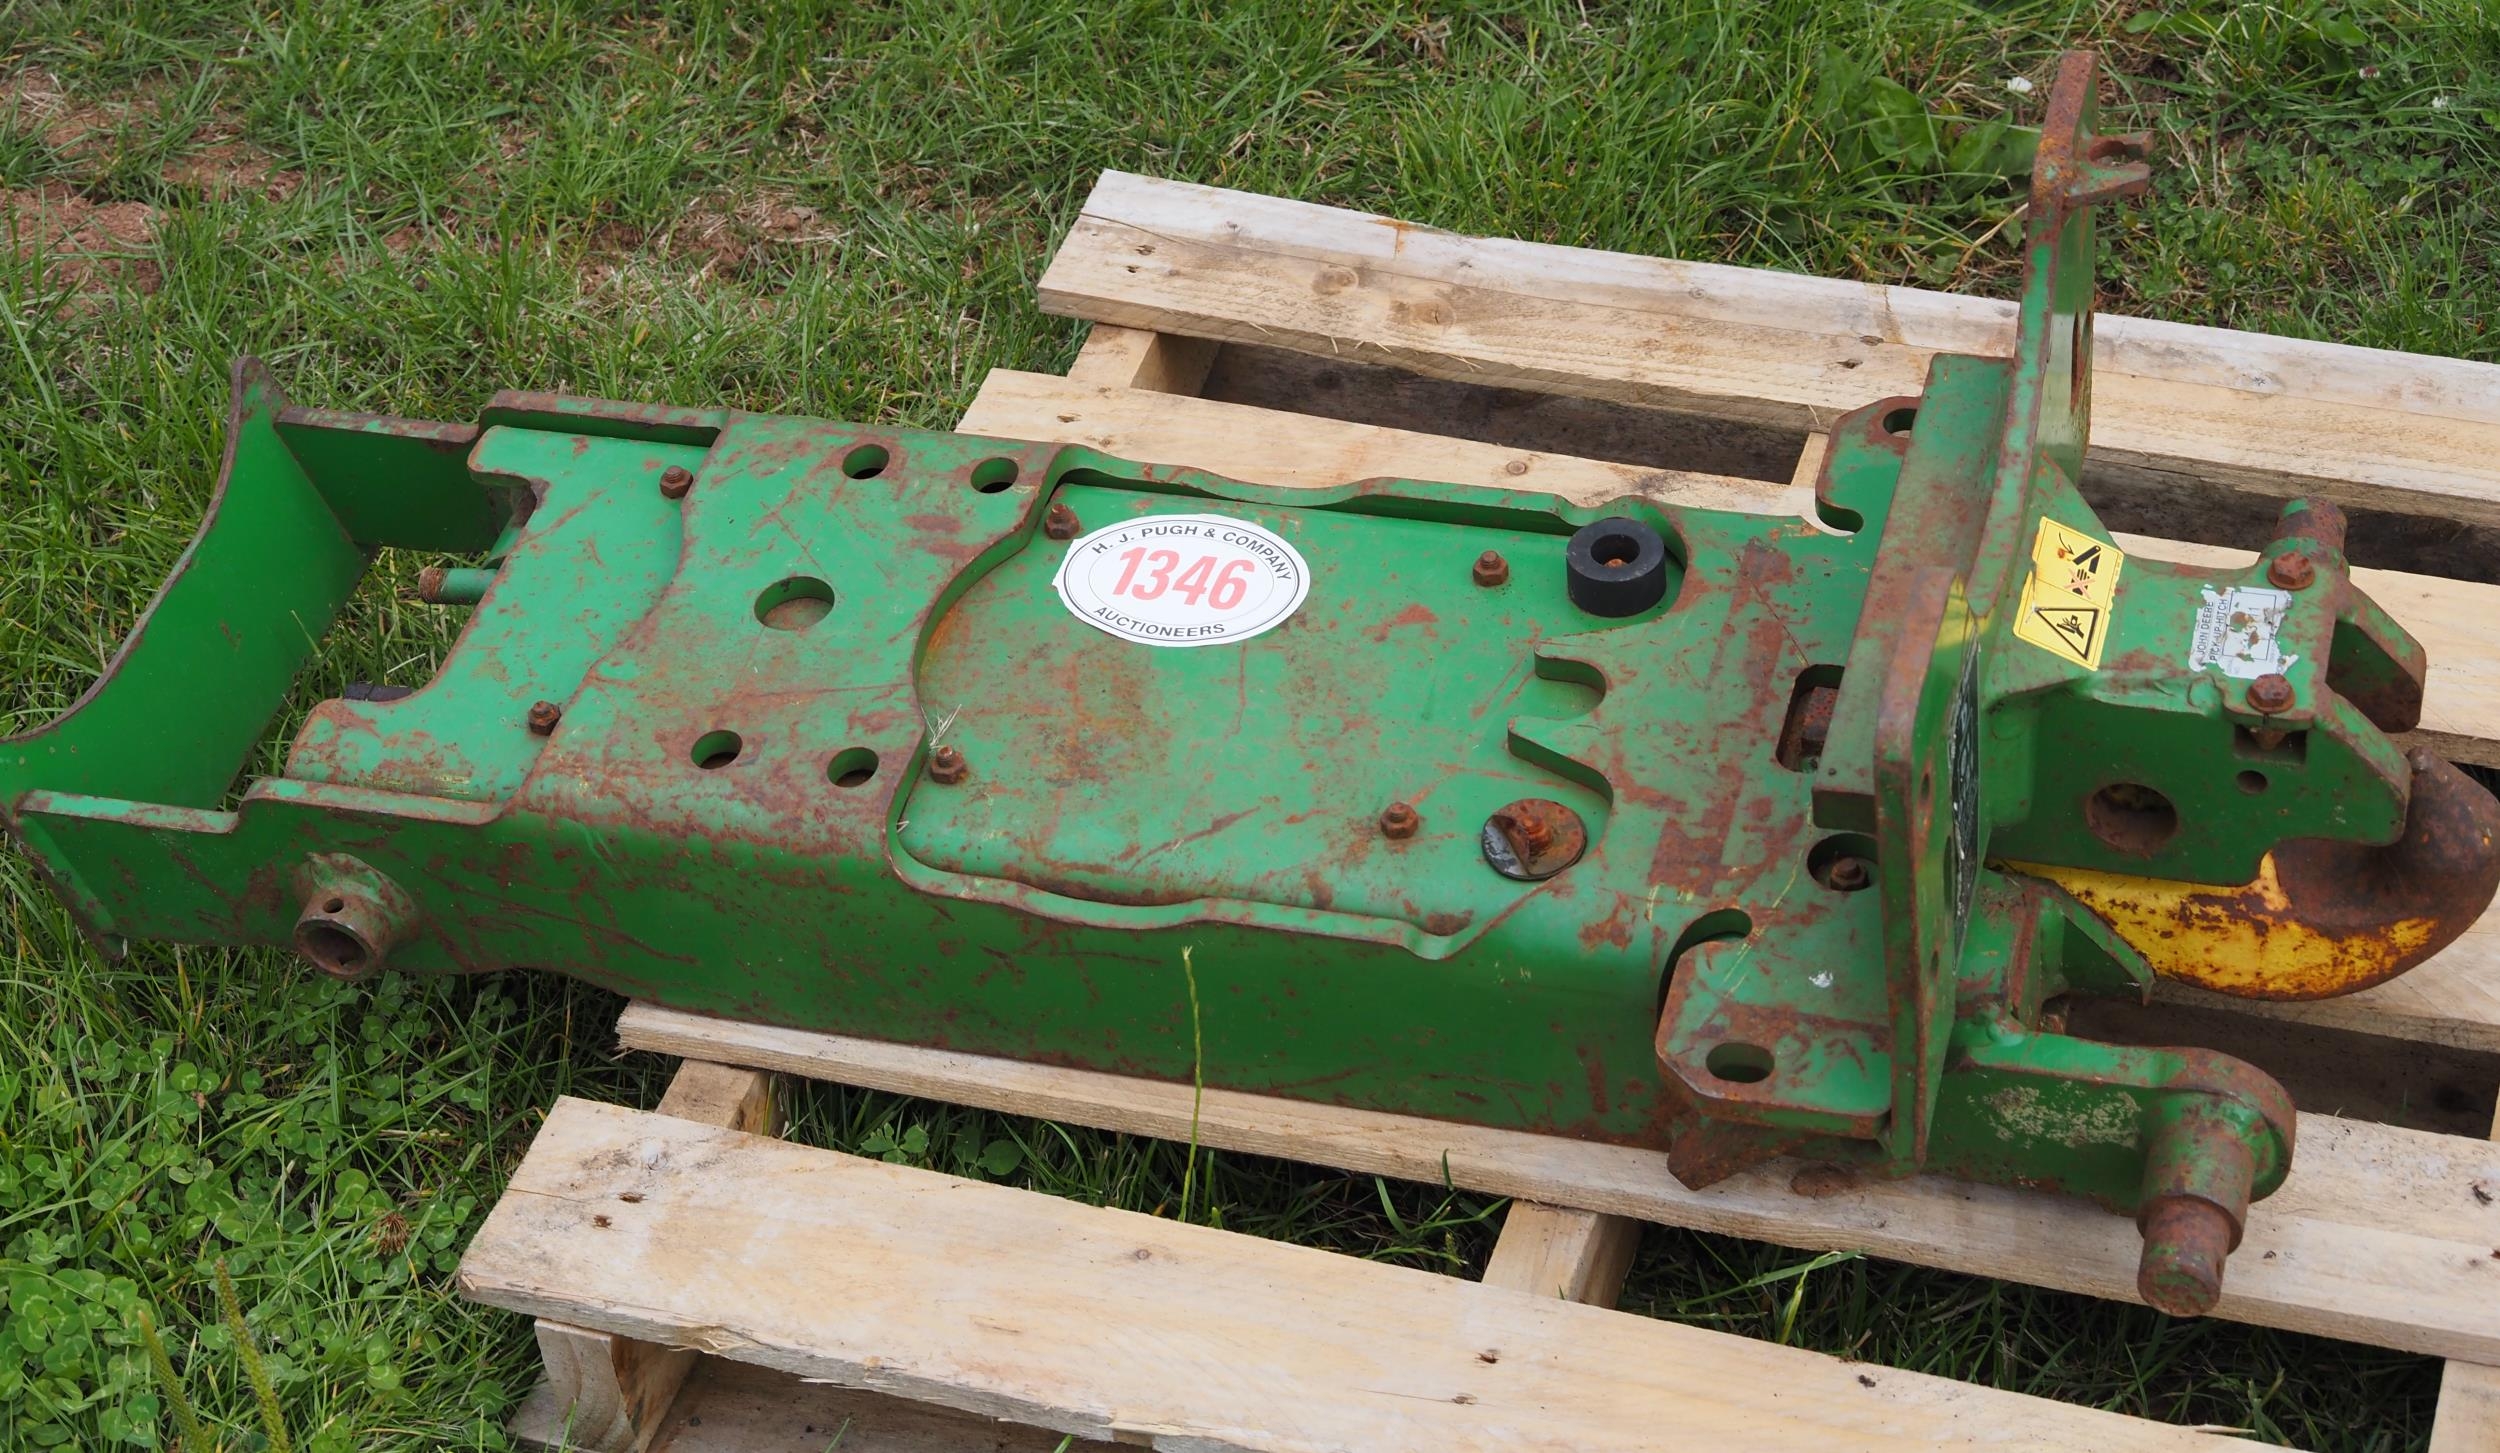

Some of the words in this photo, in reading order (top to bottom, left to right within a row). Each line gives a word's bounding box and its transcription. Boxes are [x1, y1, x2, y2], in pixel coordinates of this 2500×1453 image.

[1092, 542, 1114, 554] H.
[1119, 533, 1135, 543] J.
[1141, 525, 1198, 538] PUGH
[1204, 527, 1216, 538] &
[1222, 531, 1292, 580] COMPANY
[1112, 546, 1256, 610] 1346
[1093, 606, 1226, 637] AUCTIONEERS
[2201, 601, 2214, 630] DEERE
